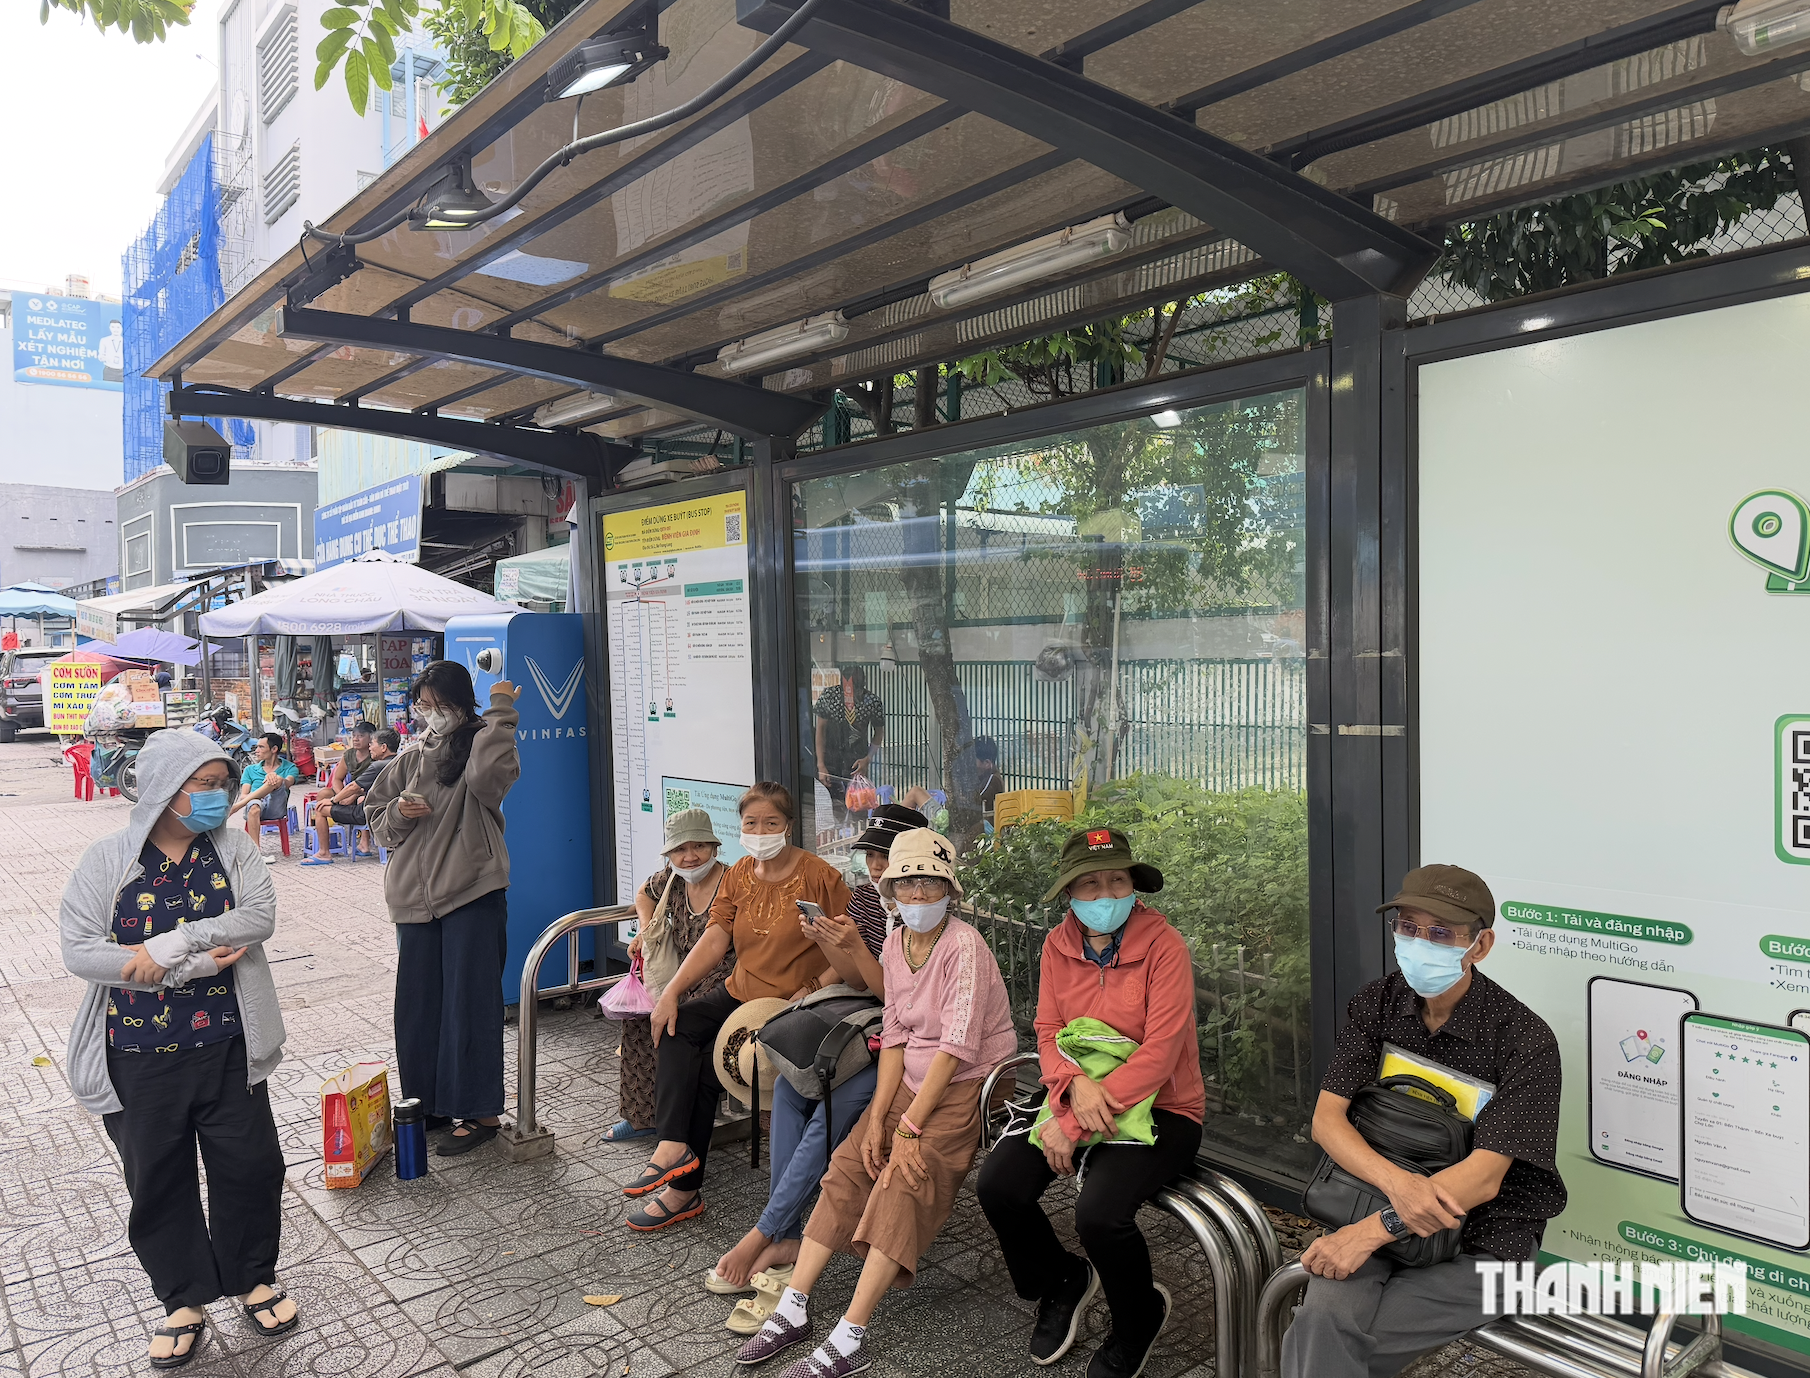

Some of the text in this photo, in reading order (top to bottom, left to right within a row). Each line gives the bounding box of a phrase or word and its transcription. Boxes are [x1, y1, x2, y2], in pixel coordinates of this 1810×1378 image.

[27, 315, 86, 330] MEDLATEC
[29, 328, 86, 344] LẤY MẪU
[18, 340, 98, 359] XÉT NGHIỆM
[32, 355, 84, 370] TẬN NƠI
[556, 480, 576, 514] SÂ
[641, 515, 652, 526] ĐIỂM
[653, 515, 666, 524] DỪNG
[674, 511, 686, 520] BUÝT
[686, 510, 698, 520] (BUS
[698, 507, 712, 517] STOP)
[326, 536, 339, 562] HÀNG
[363, 518, 374, 552] THỂ
[387, 510, 399, 545] THỂ
[400, 514, 417, 541] THAO
[662, 533, 672, 541] BỆNH
[673, 531, 681, 539] VIỆN
[690, 529, 700, 537] ĐỊNH
[432, 595, 478, 603] NGÀY
[310, 623, 341, 632] 6928
[382, 640, 408, 653] TẠP
[53, 665, 98, 678] CƠM SƯỜN
[518, 726, 586, 740] VINFAS
[720, 793, 737, 801] MultiGo
[1507, 905, 1685, 942] Bước 1: Tải và đăng nhập
[1517, 927, 1638, 953] Tải ứng dụng MultiGo
[1517, 941, 1674, 973] Đăng nhập theo hướng dẫn
[1768, 940, 1810, 958] Bước
[1776, 964, 1802, 977] Tìm
[1776, 979, 1809, 994] Xem
[1617, 1070, 1668, 1087] ĐĂNG NHẬP
[1694, 1139, 1712, 1147] Nguyễn
[1625, 1225, 1664, 1248] Bước
[1668, 1239, 1683, 1253] 3:
[1687, 1245, 1718, 1263] Chủ
[1723, 1256, 1766, 1280] động
[1769, 1270, 1784, 1284] di
[1570, 1229, 1601, 1247] Nhận
[1604, 1241, 1638, 1260] thông
[1641, 1251, 1664, 1266] báo
[1749, 1287, 1765, 1299] và
[1768, 1294, 1810, 1315] xuống
[1745, 1300, 1773, 1316] chất
[1776, 1307, 1810, 1330] lượng
